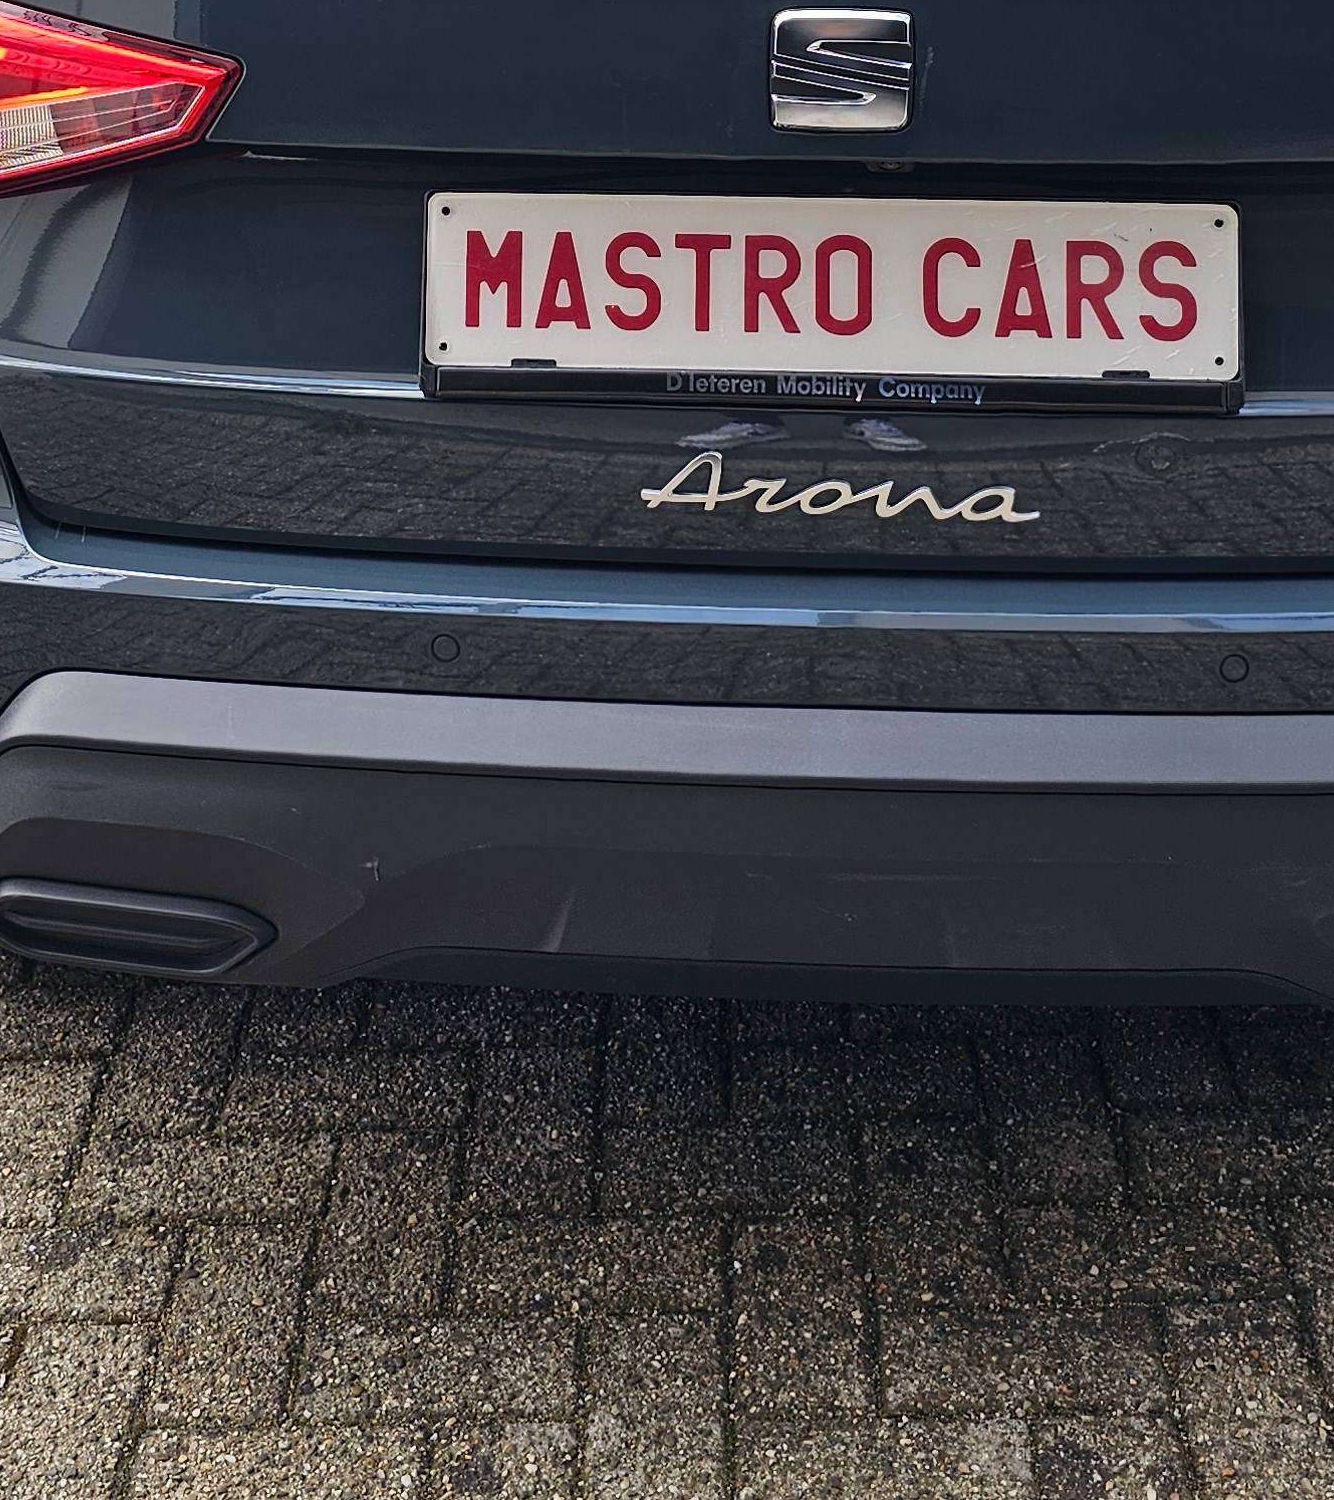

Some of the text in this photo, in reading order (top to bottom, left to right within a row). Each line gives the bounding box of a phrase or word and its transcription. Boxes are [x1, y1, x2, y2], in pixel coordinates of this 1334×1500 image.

[465, 231, 1198, 342] MASTRO CARS
[776, 375, 867, 402] Mobility
[878, 377, 986, 405] Company
[640, 450, 1041, 523] Arona
